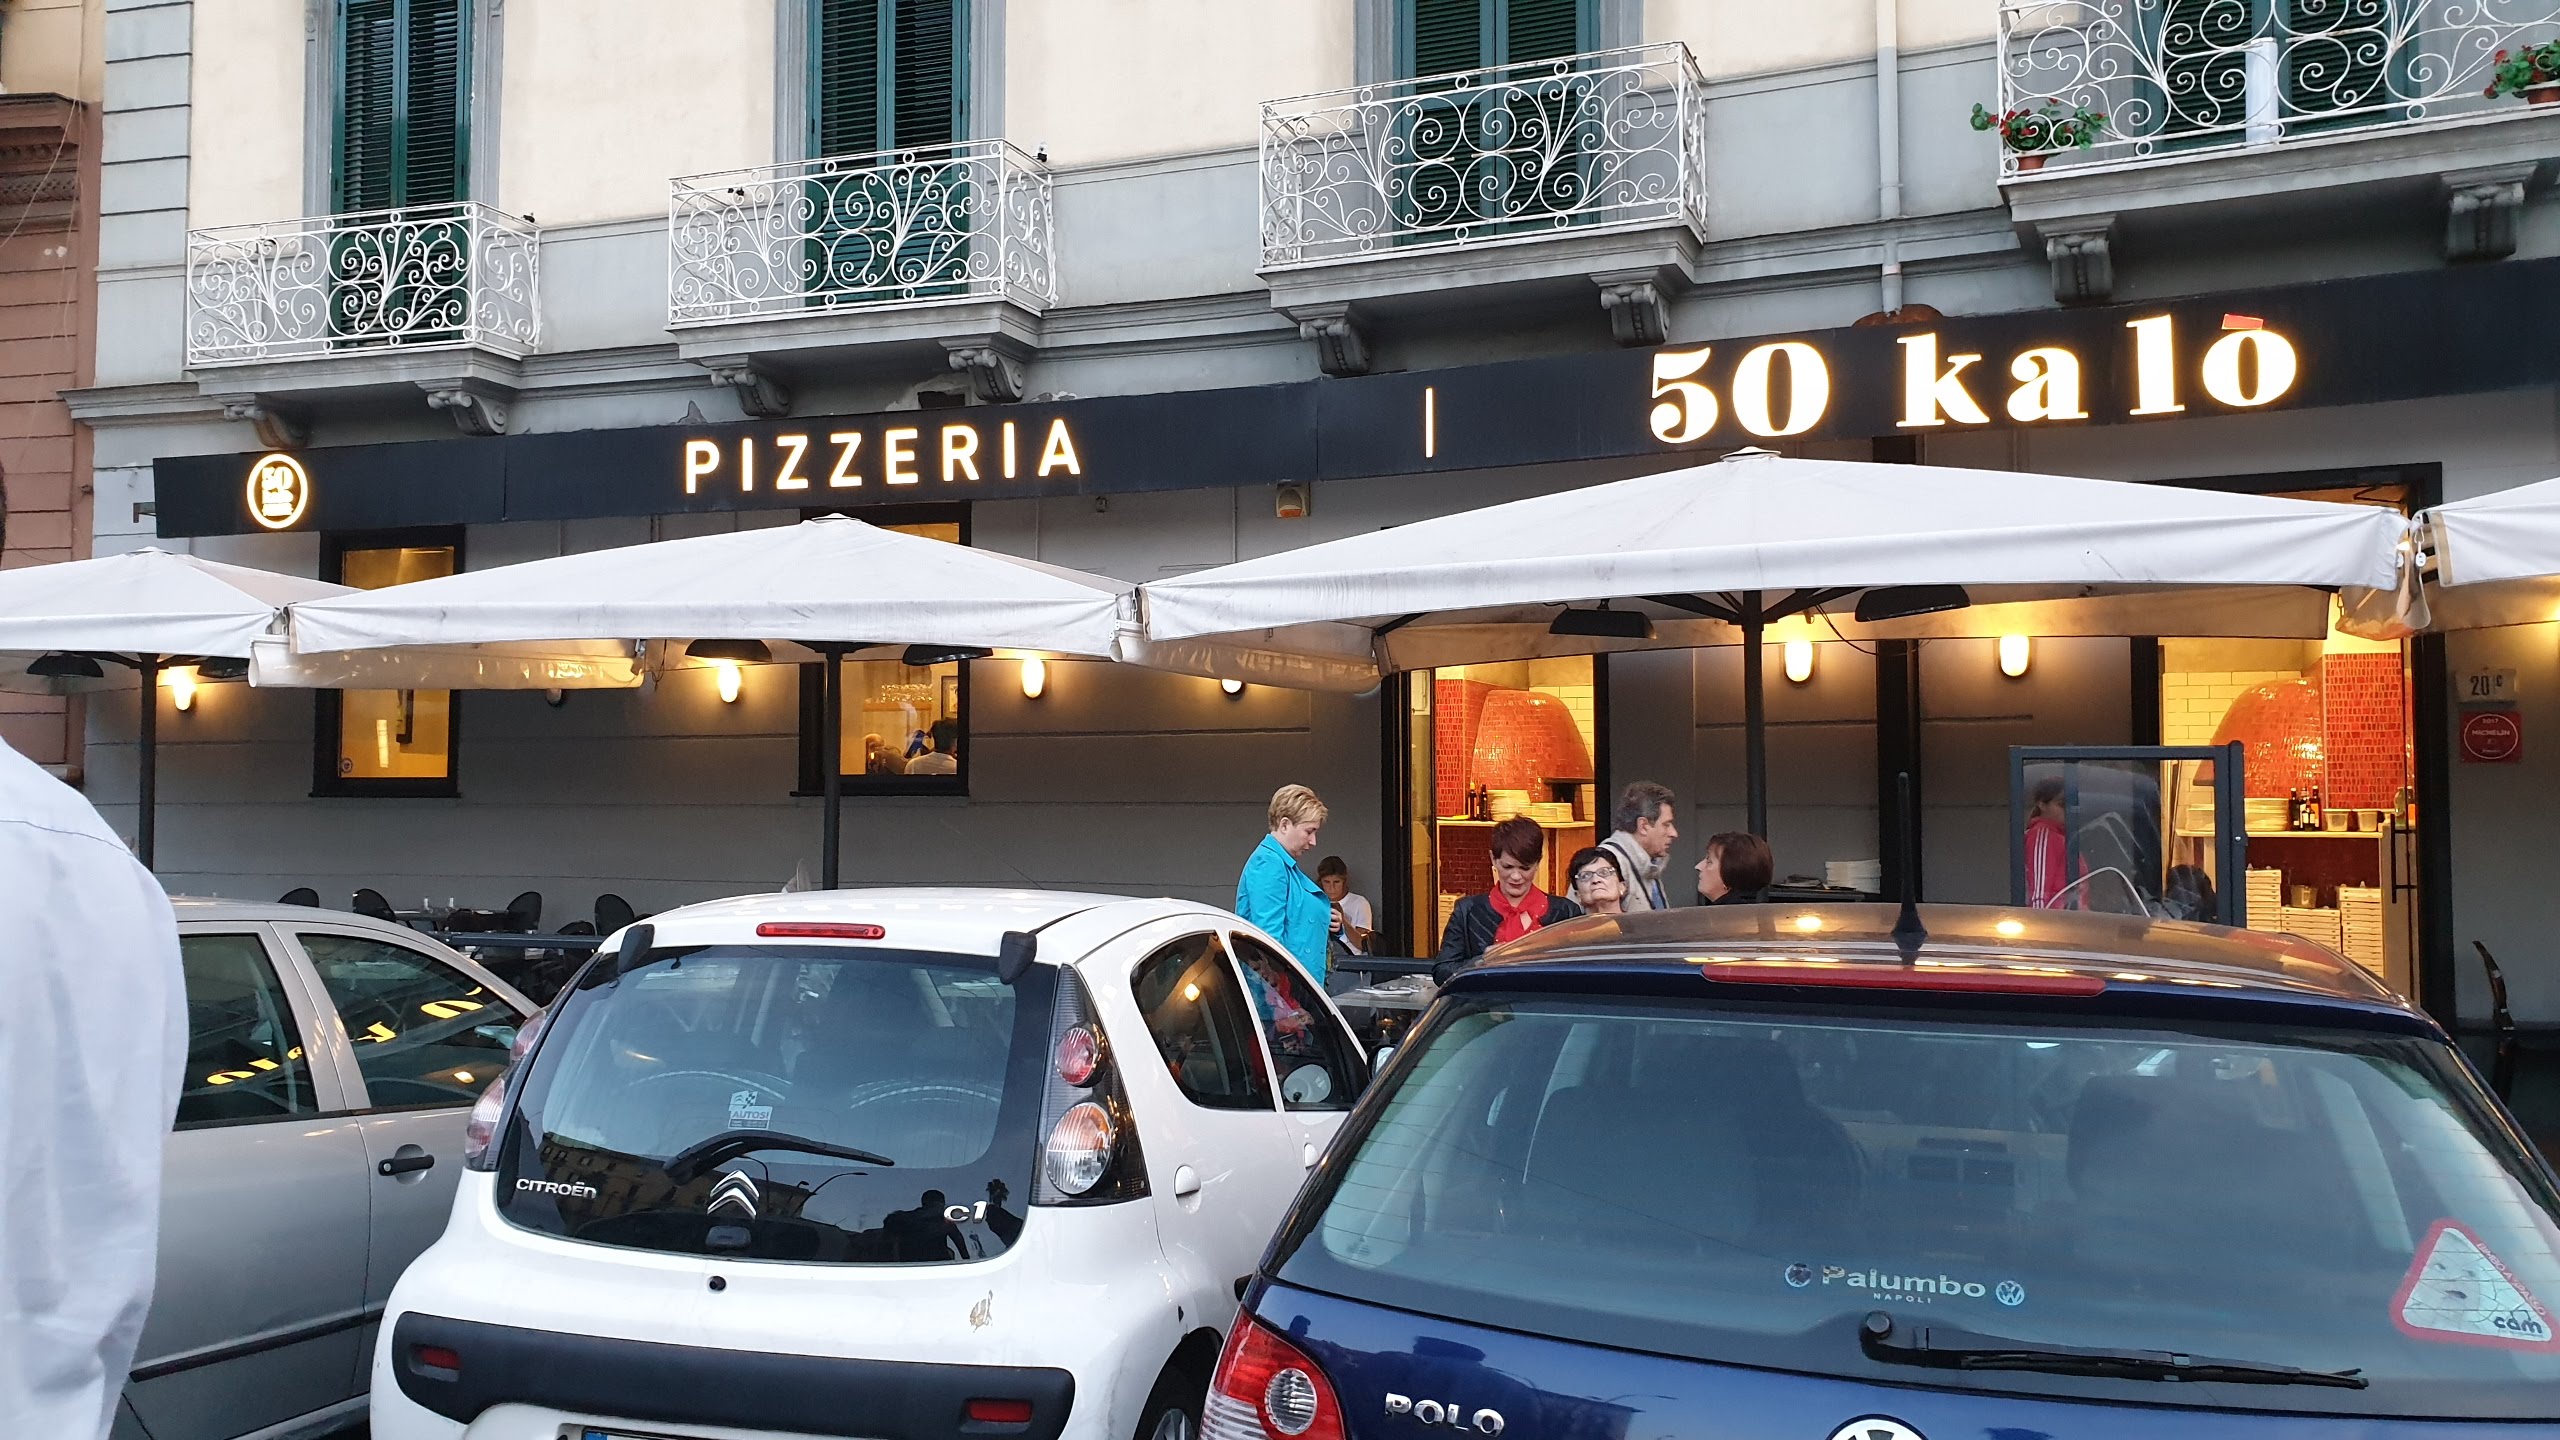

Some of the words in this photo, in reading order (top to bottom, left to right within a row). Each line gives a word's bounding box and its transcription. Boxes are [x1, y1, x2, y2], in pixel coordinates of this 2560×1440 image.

[1649, 342, 1830, 444] 50
[1895, 313, 2297, 428] kalò
[686, 419, 1081, 494] PIZZERIA
[2470, 675, 2490, 696] 20
[1822, 1265, 1986, 1298] Palumbo
[1873, 1292, 1931, 1304] NAPOLI
[1384, 1392, 1505, 1437] POLO
